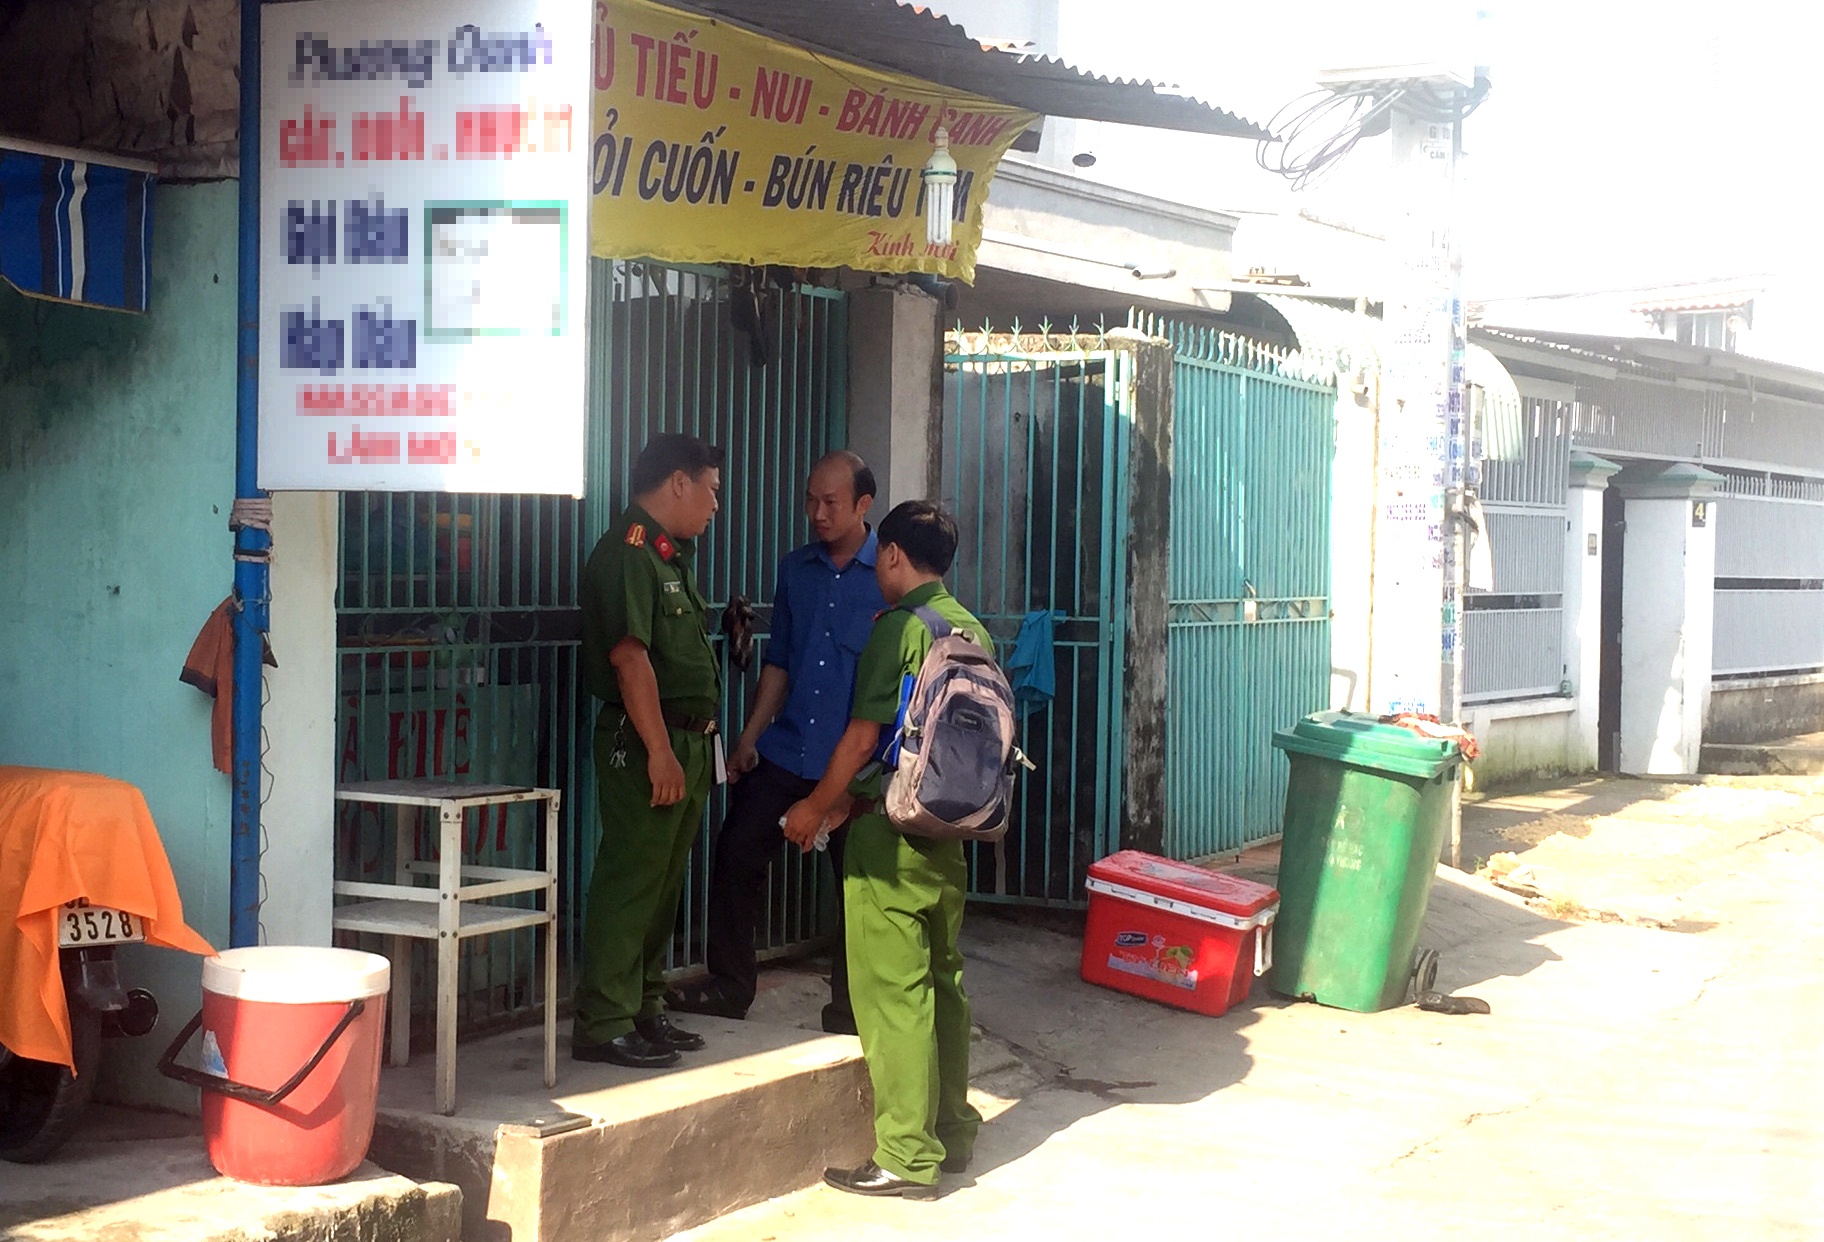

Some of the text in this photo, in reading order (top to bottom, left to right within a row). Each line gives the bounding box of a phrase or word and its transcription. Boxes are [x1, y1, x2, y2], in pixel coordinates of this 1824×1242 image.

[631, 29, 718, 109] TIẾU
[750, 66, 813, 125] NUI
[836, 87, 931, 142] BÁNH
[638, 126, 741, 205] CUỐN
[762, 145, 837, 210] BÚN
[836, 154, 912, 219] RIÊU
[66, 910, 133, 942] 3528
